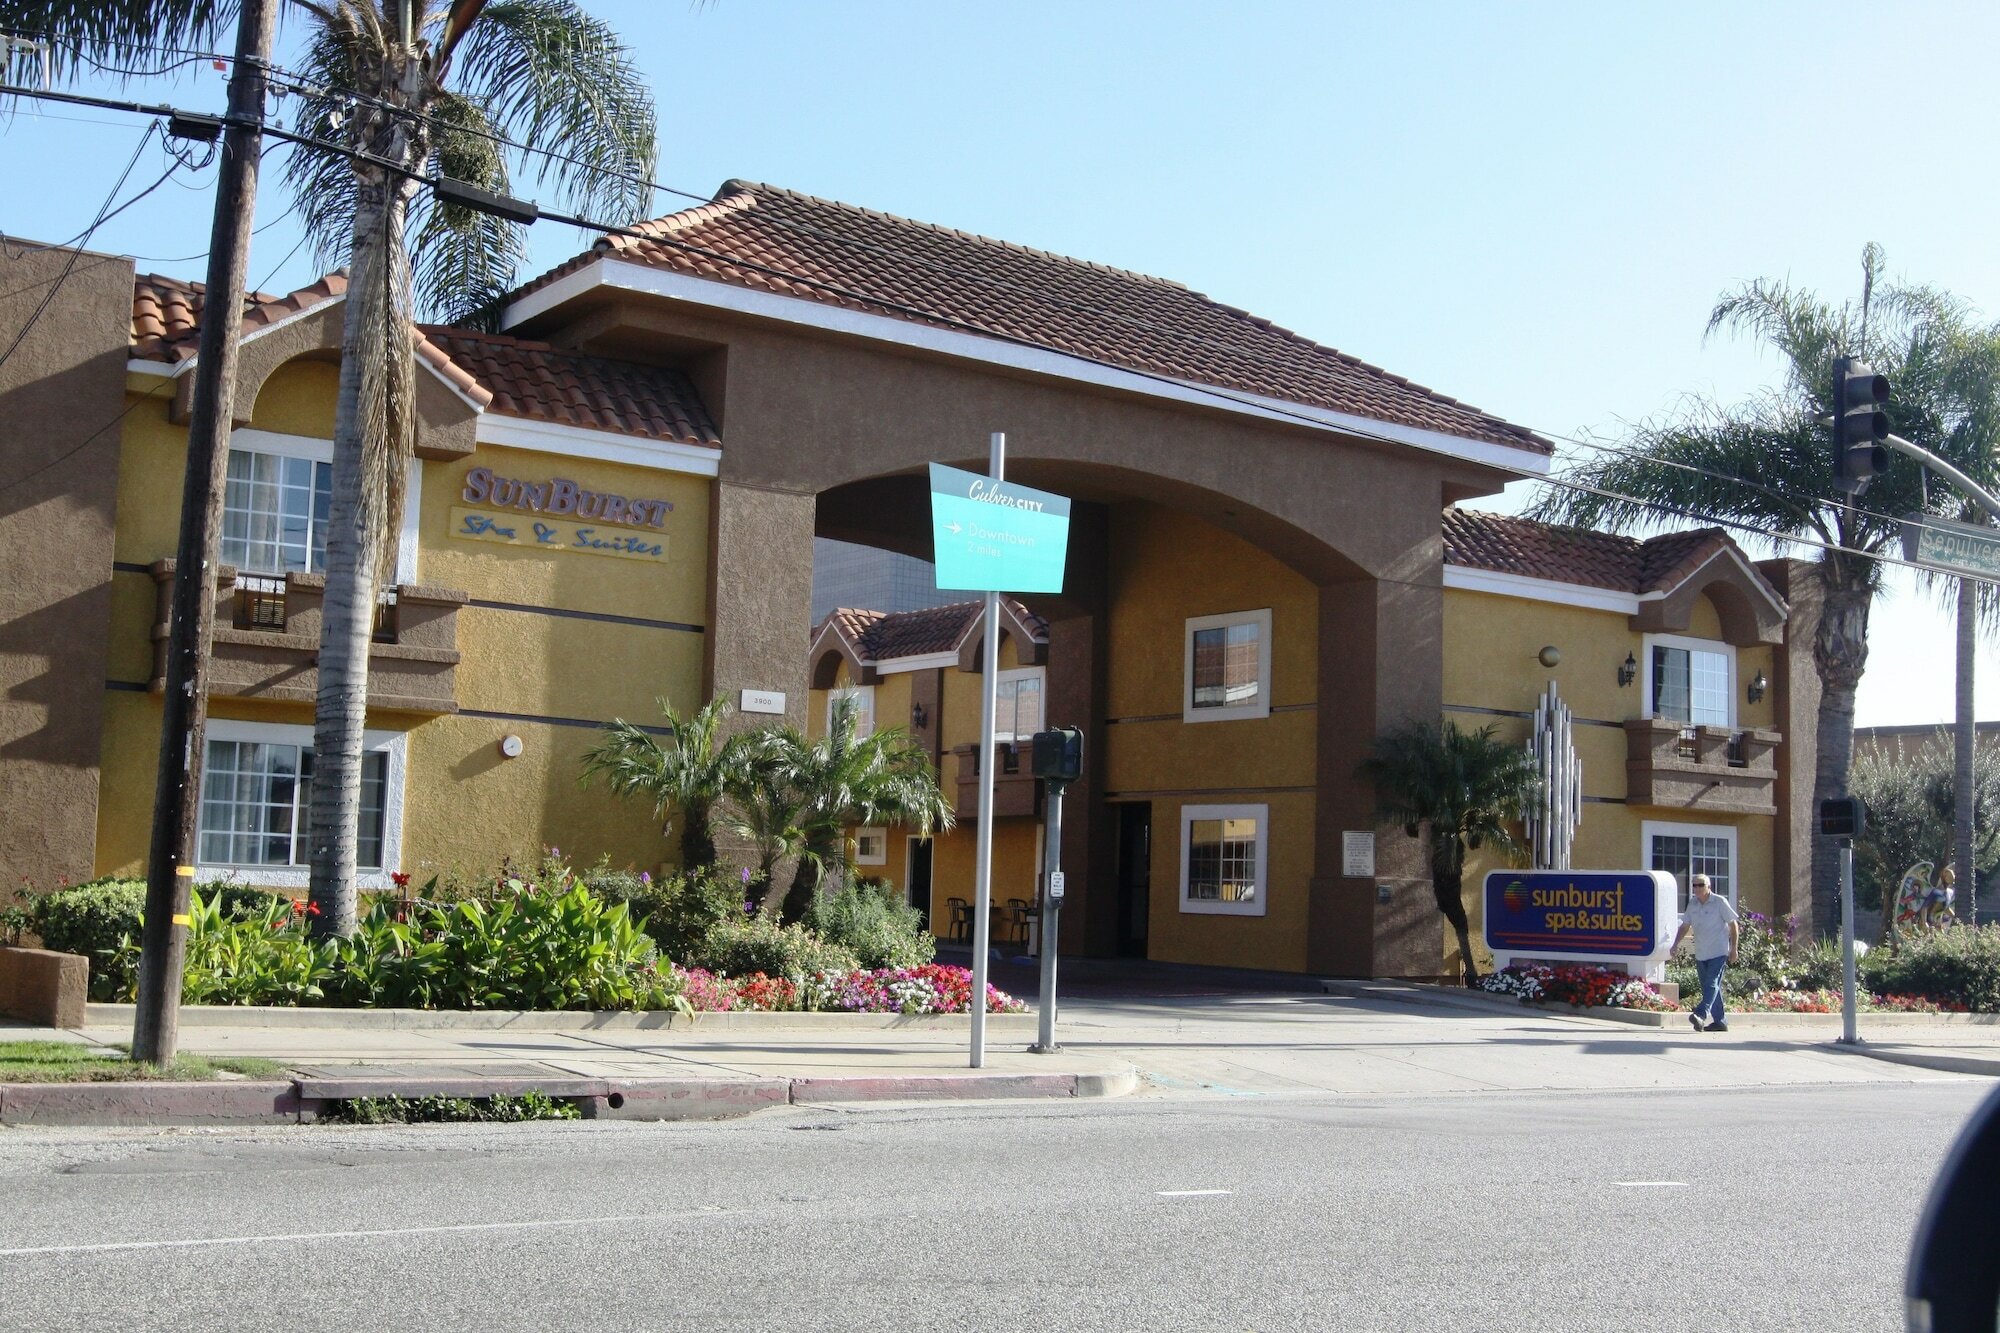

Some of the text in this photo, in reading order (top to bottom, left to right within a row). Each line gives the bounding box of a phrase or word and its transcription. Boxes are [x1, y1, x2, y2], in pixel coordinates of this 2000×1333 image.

[969, 479, 1043, 513] Culver CITY
[573, 528, 664, 556] Suites
[969, 519, 1035, 547] Downtown
[977, 544, 1001, 557] miles
[753, 697, 772, 705] 3900
[1532, 882, 1624, 910] sunburst
